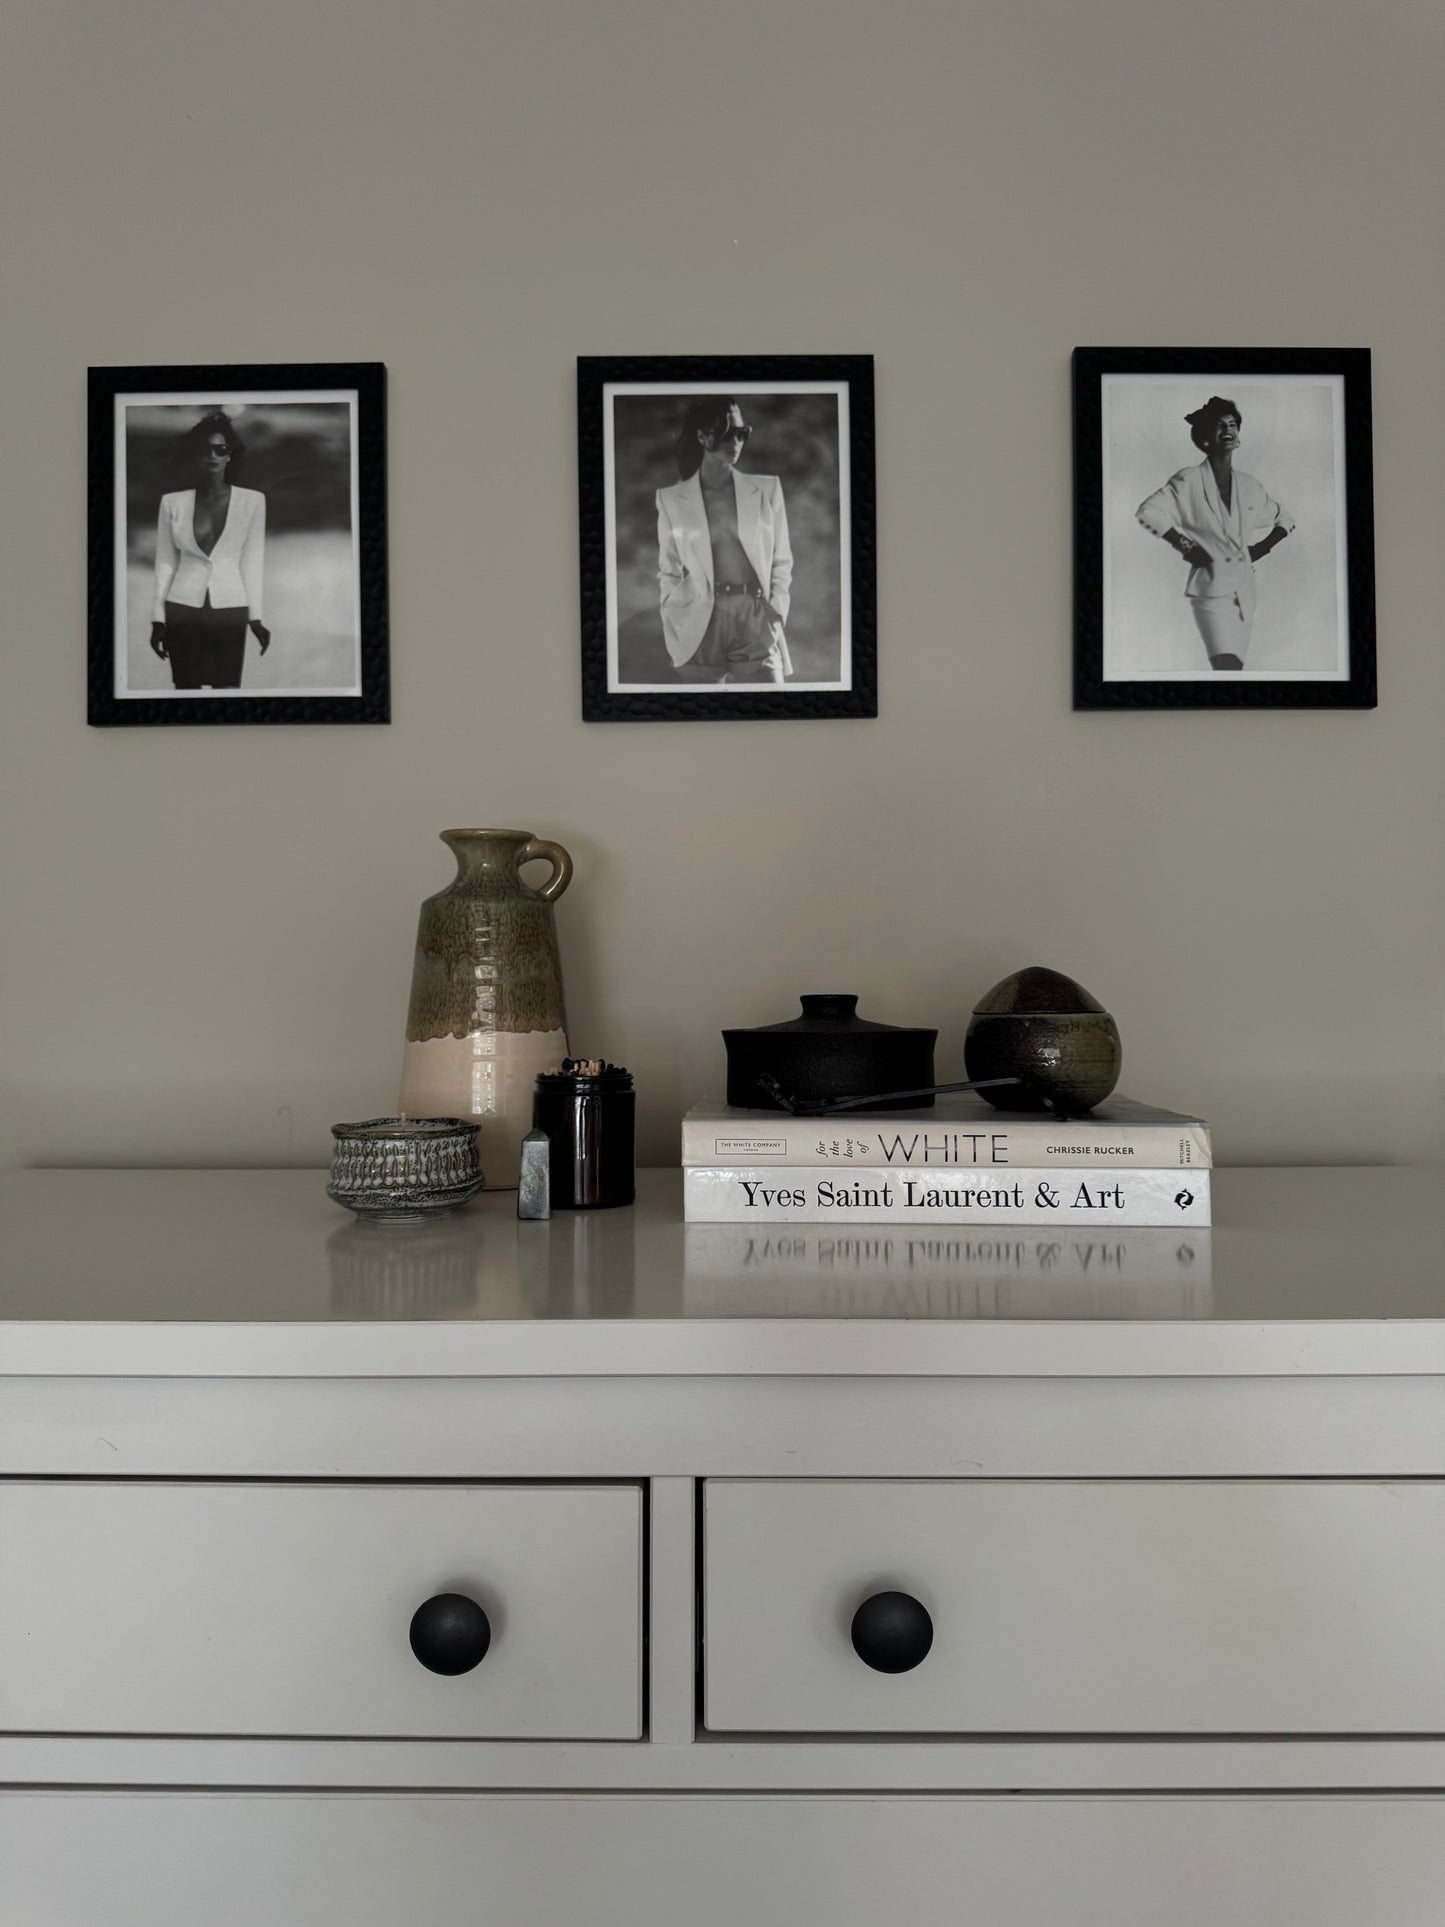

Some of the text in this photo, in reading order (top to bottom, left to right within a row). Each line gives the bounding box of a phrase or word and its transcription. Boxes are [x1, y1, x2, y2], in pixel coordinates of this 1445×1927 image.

[815, 1140, 829, 1158] for
[829, 1140, 840, 1156] the
[842, 1138, 853, 1158] love
[856, 1140, 870, 1154] of
[877, 1134, 1009, 1163] WHITE
[1046, 1145, 1135, 1156] CHRISSIE RUCKER
[738, 1180, 1126, 1209] Yves Saint Laurent & Art
